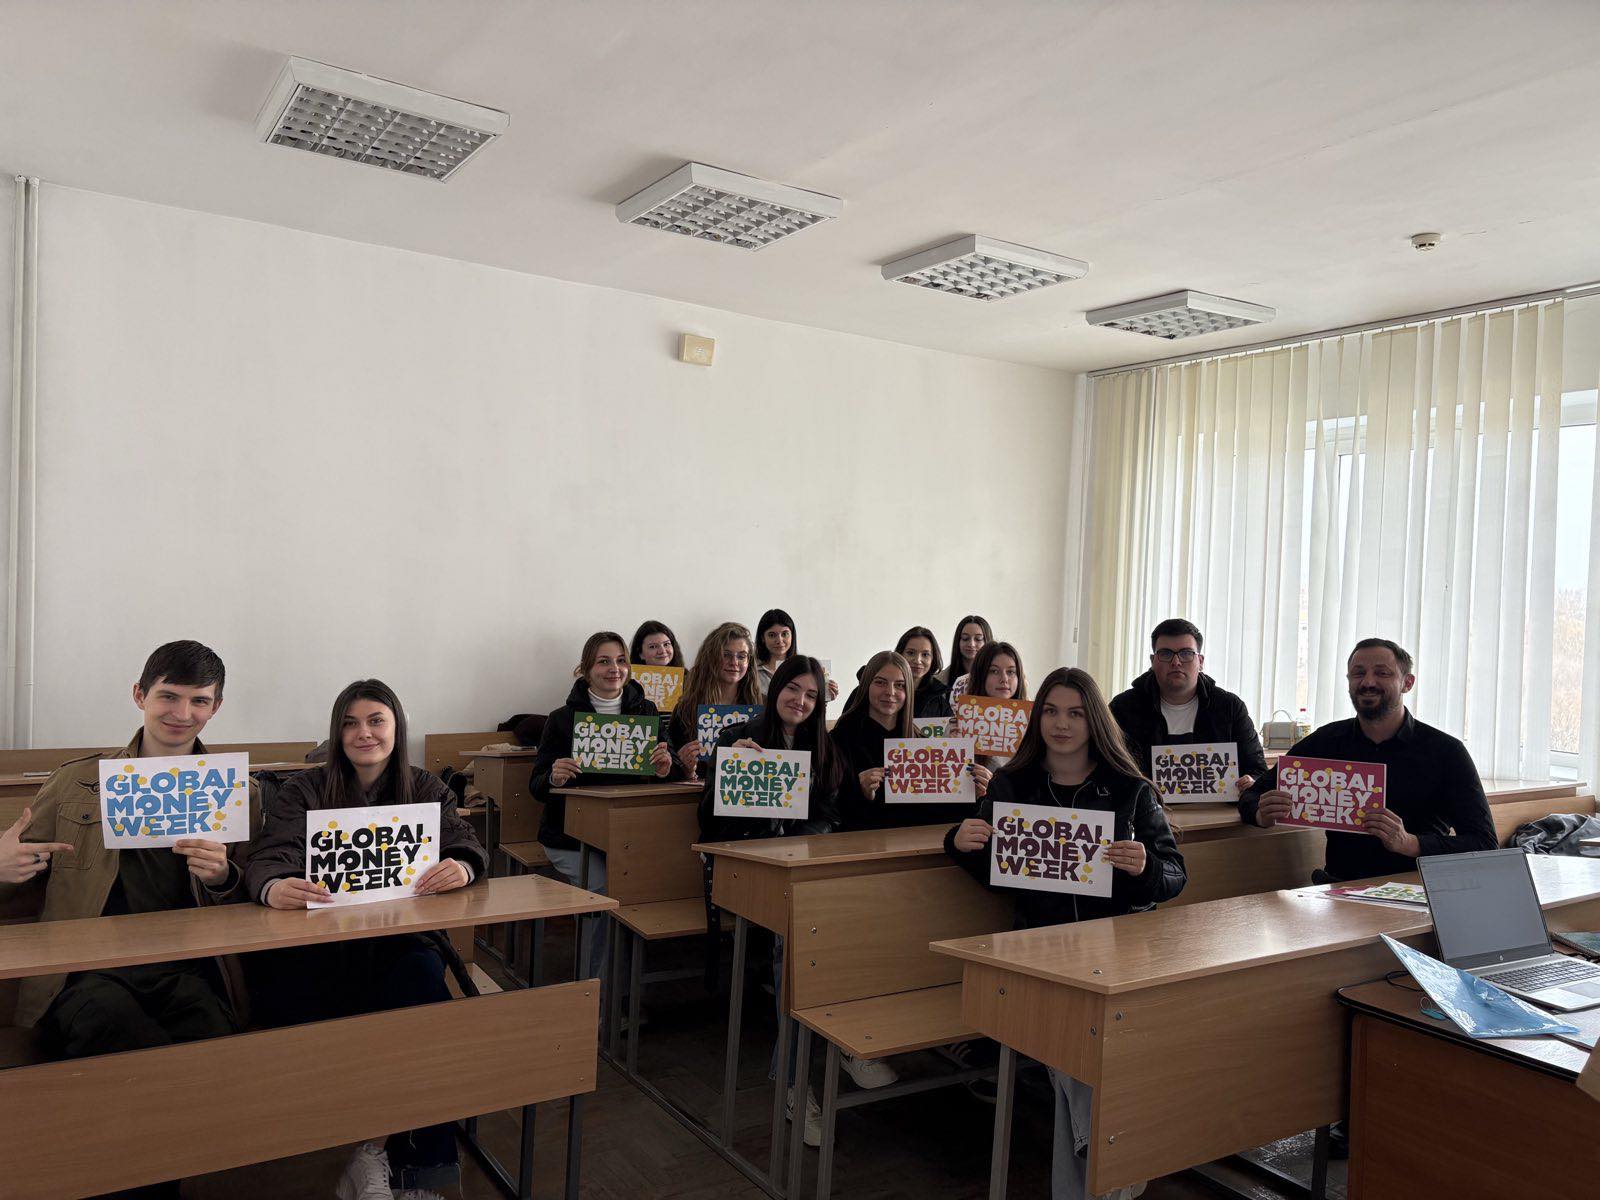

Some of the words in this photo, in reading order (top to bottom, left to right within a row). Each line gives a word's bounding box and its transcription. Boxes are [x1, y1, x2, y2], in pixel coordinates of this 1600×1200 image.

[959, 704, 1029, 724] GLOBA
[573, 737, 650, 755] MONEY
[572, 751, 635, 770] WEEK
[889, 763, 965, 779] MONEY
[1155, 766, 1229, 781] MONEY
[720, 775, 798, 792] MONEY
[888, 778, 952, 794] WEEK
[1156, 780, 1218, 795] WEEK
[107, 788, 233, 816] MONEY
[719, 789, 783, 808] WEEK
[107, 811, 212, 836] WEEK
[310, 844, 422, 874] MONEY
[996, 836, 1100, 863] MONEY
[995, 855, 1080, 882] WEEK
[309, 866, 404, 894] WEEK
